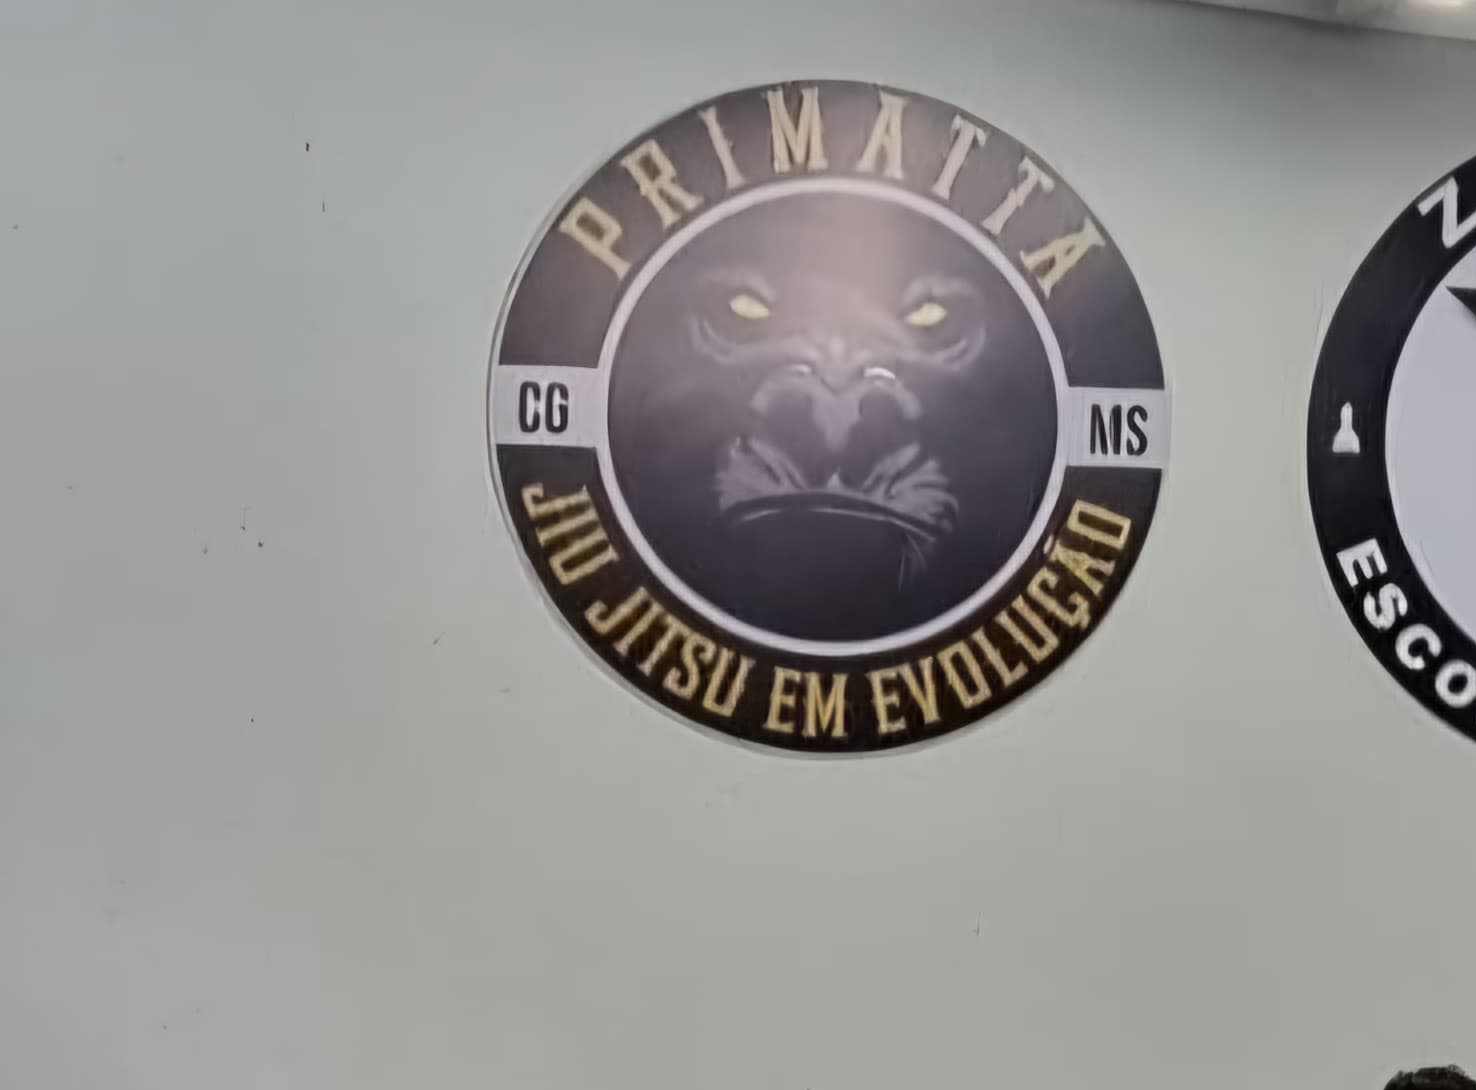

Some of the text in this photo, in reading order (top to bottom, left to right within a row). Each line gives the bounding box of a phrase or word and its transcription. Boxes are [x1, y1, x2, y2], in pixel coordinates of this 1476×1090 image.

[558, 86, 1107, 299] PRIMATTA
[518, 381, 569, 433] CG
[1089, 403, 1148, 456] MS
[521, 482, 1132, 738] JIU JITSU EM EVOLUÇÃO
